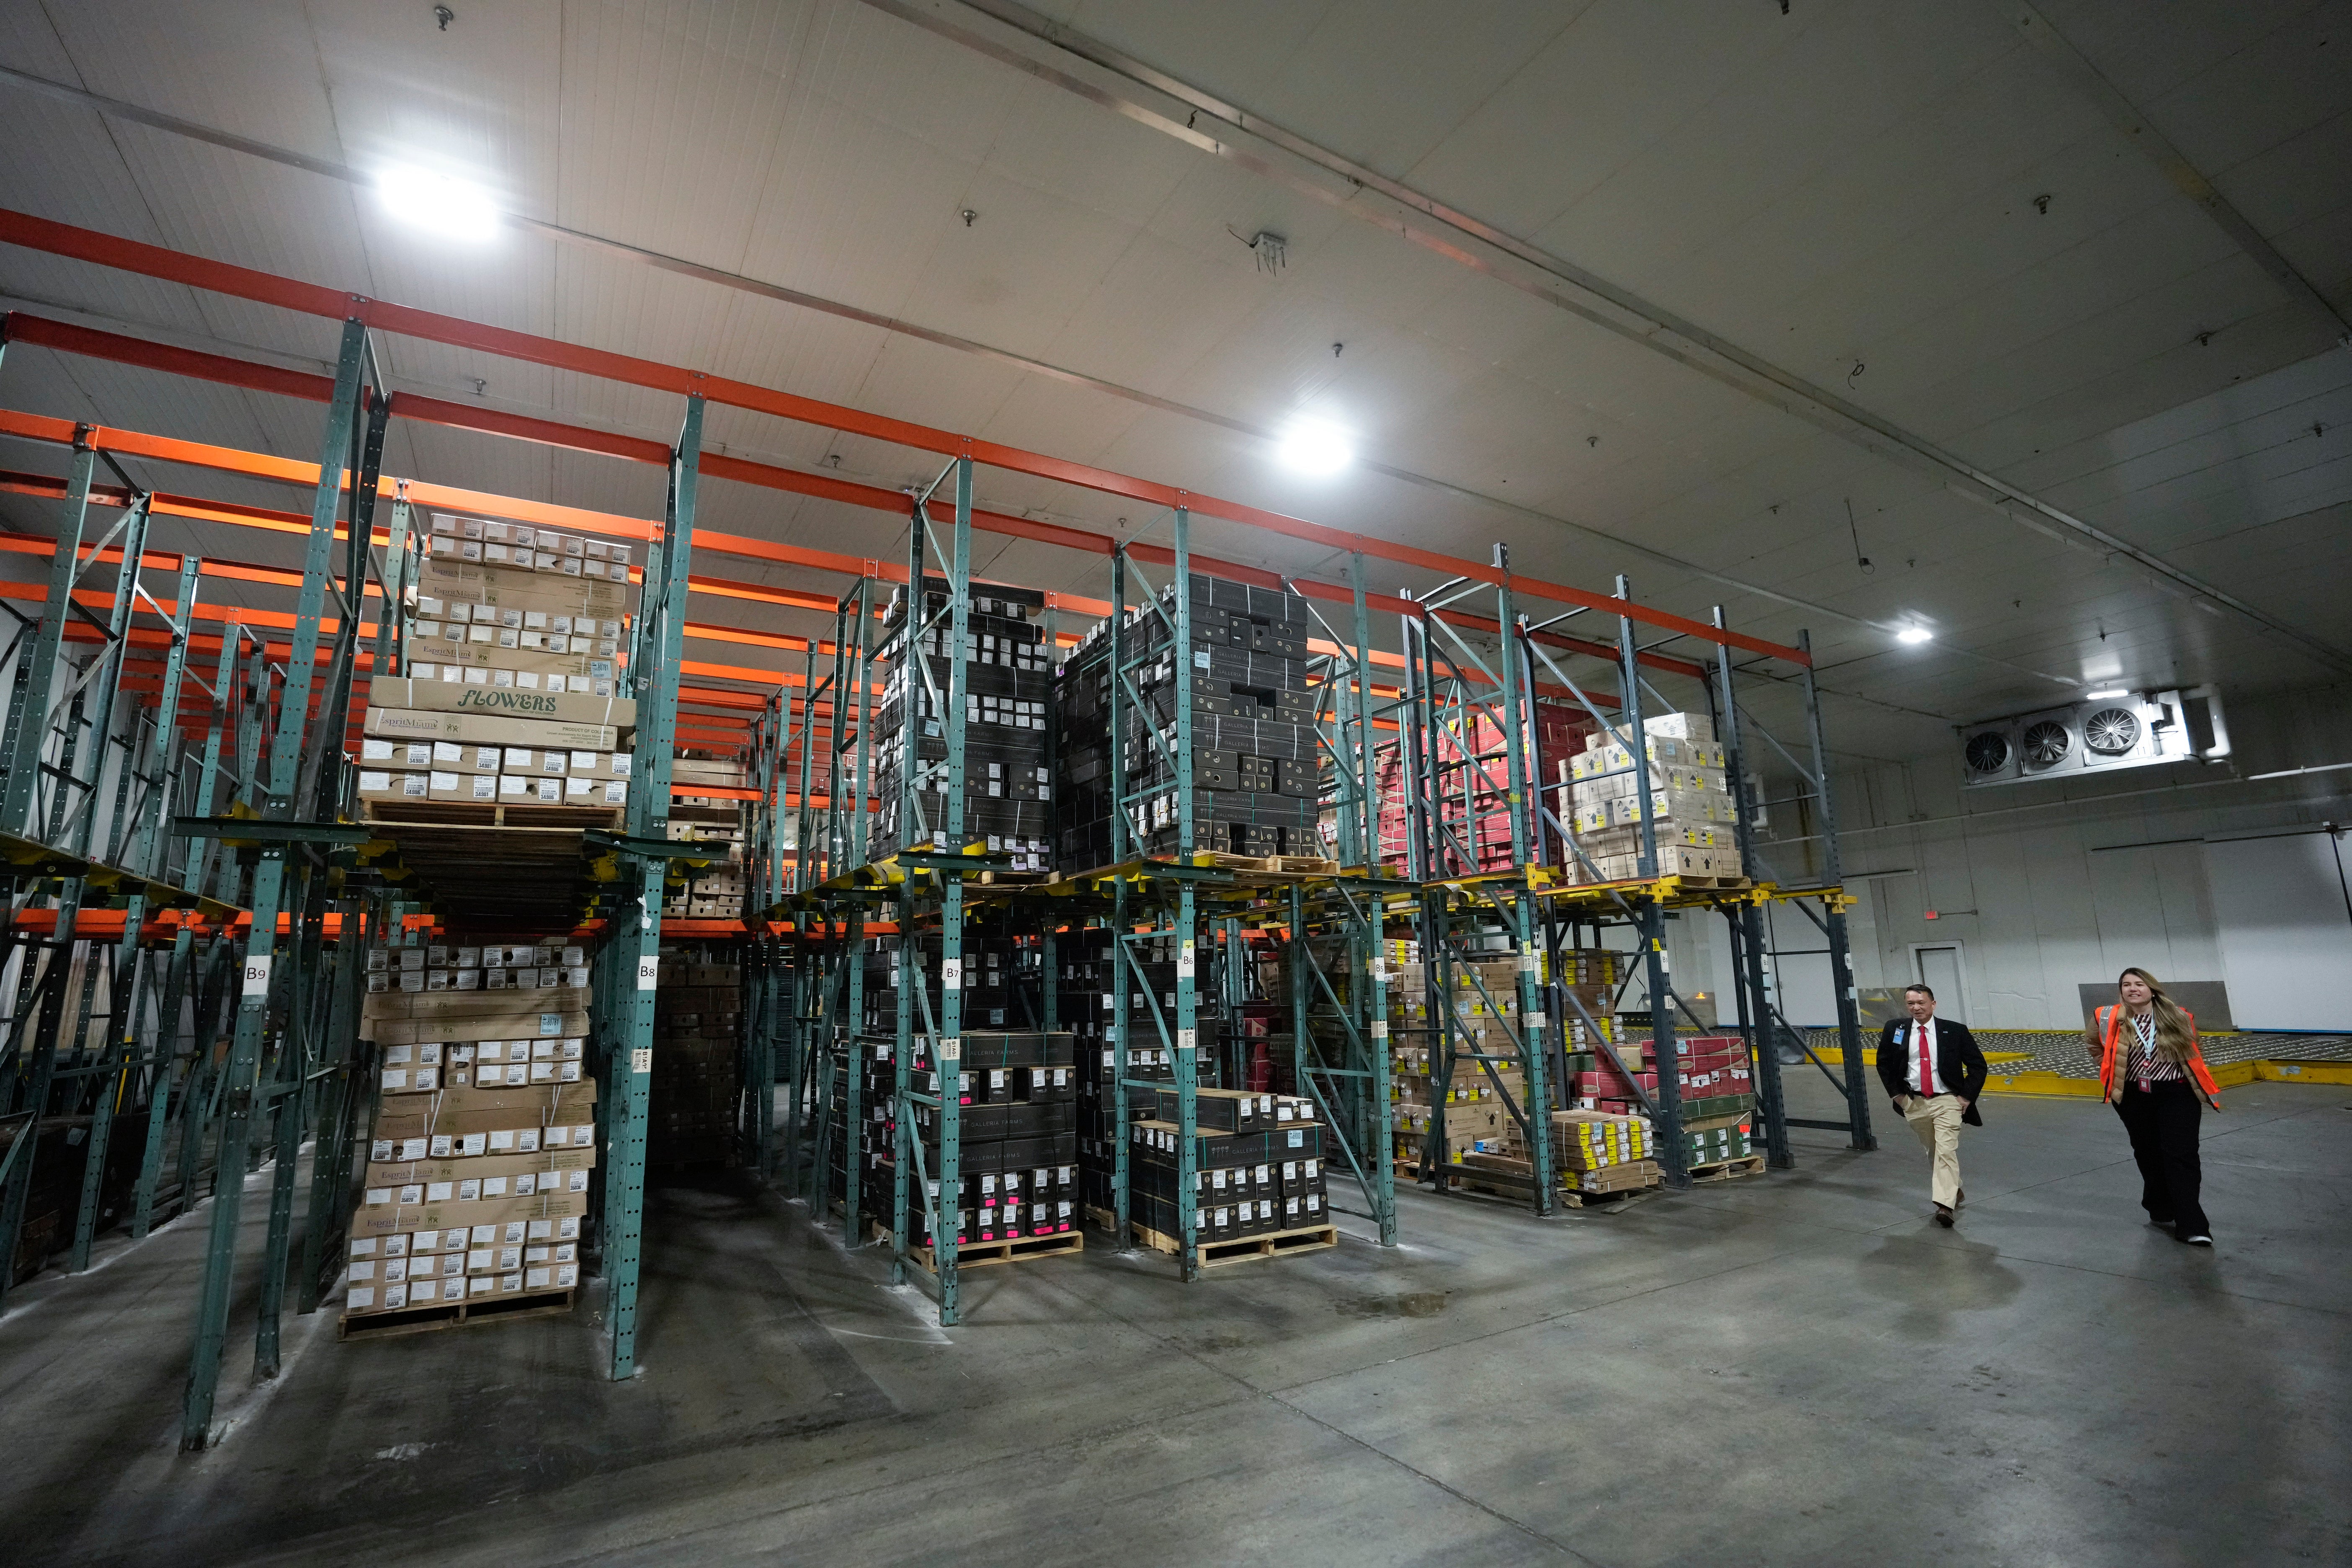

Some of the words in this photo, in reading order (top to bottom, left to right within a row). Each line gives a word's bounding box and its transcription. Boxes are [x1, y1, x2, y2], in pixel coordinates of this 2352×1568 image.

[1218, 652, 1241, 660] GALLERIA
[457, 689, 557, 712] FLOWERS
[2137, 747, 2146, 756] 11
[1184, 956, 1193, 965] B6
[246, 967, 266, 980] B9
[640, 966, 655, 977] B8
[947, 968, 959, 977] B7
